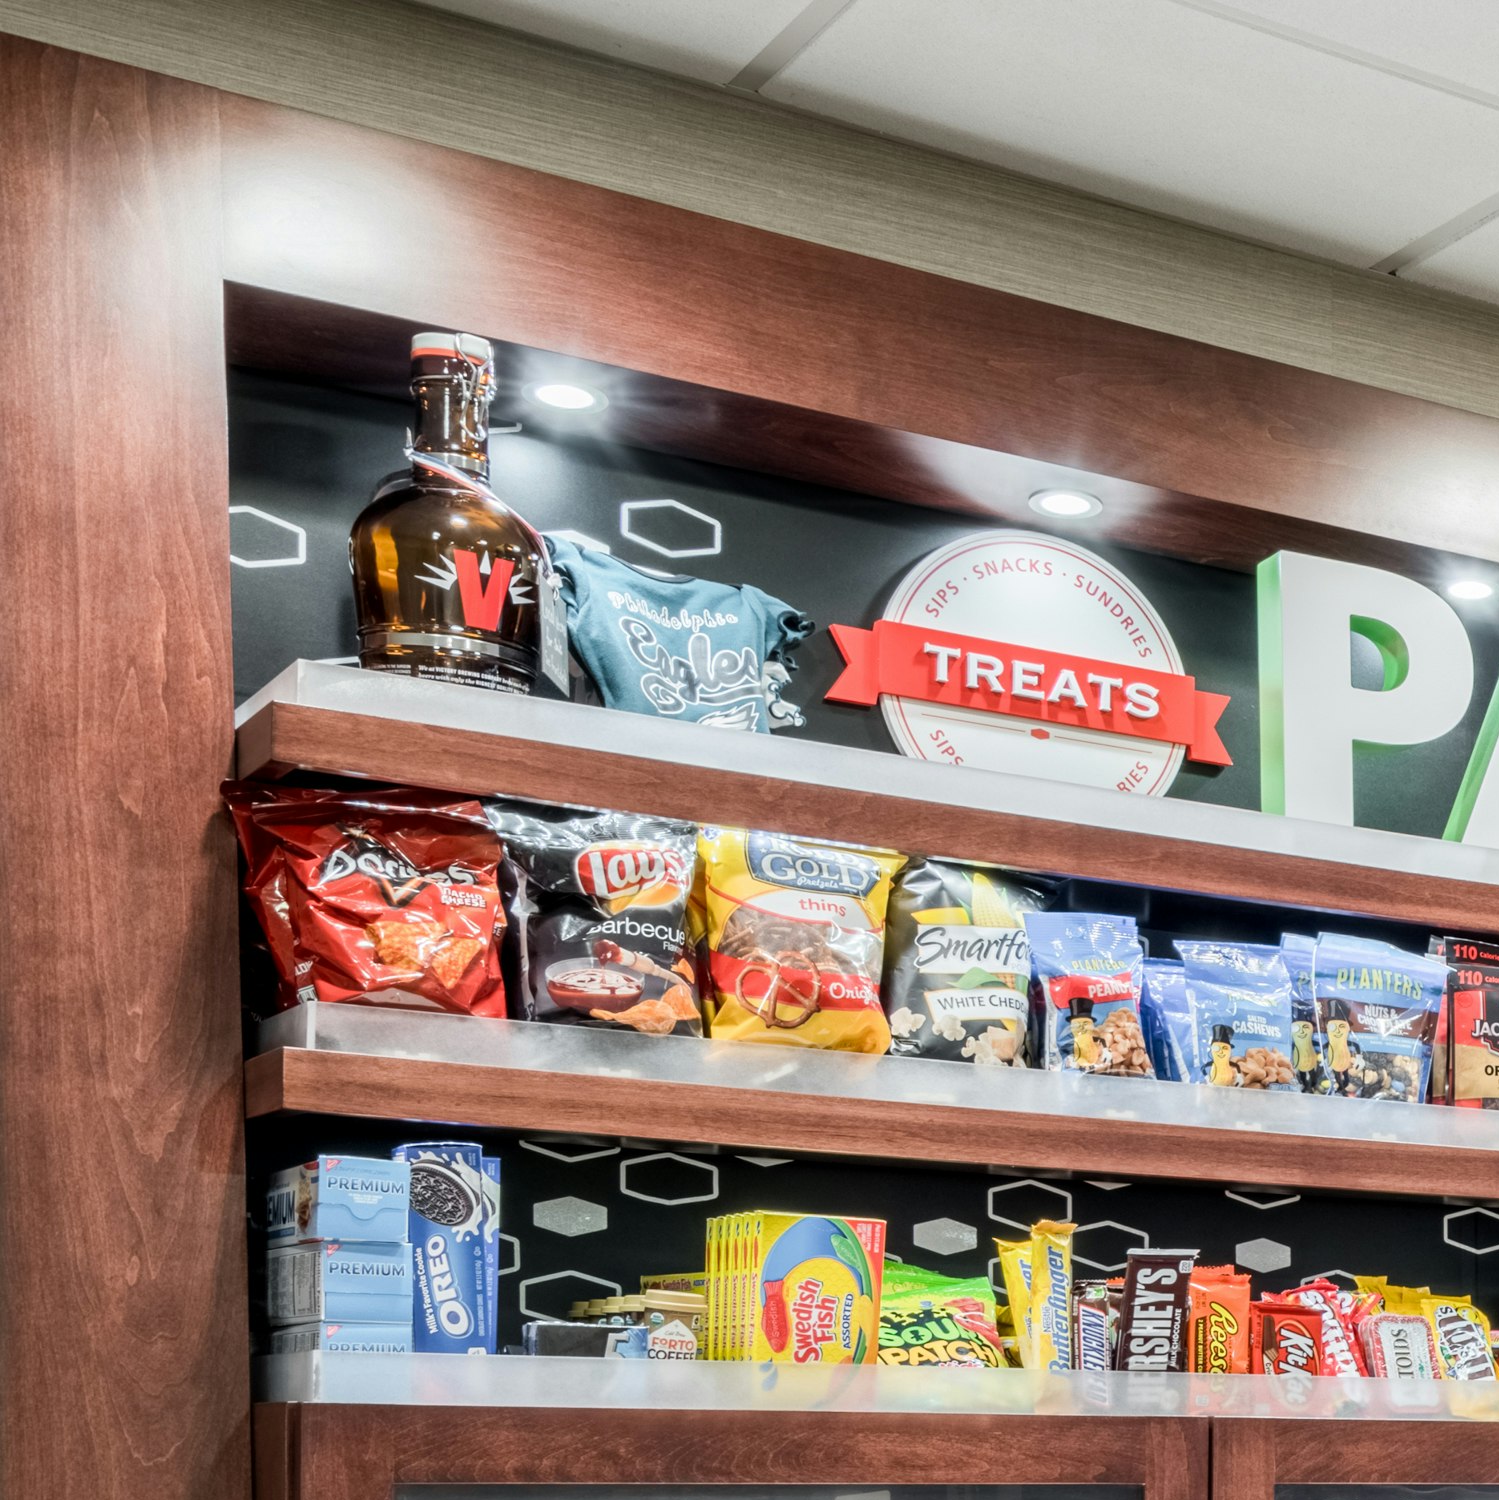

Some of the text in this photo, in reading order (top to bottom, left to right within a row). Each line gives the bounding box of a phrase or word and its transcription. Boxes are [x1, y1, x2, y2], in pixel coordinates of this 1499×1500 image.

[453, 548, 515, 633] V
[925, 558, 1153, 658] SIPS SNACKS SUNDRIES
[607, 591, 739, 633] Philadelphia
[619, 615, 763, 710] Eagles
[922, 642, 1160, 719] TREATS
[761, 853, 870, 891] GOLD
[441, 896, 487, 909] CHEESE
[798, 898, 847, 918] thins
[1453, 944, 1478, 961] 110
[1336, 967, 1423, 1000] PLANTERS
[1457, 969, 1483, 986] 110
[937, 996, 986, 1011] WHITE
[1364, 1004, 1389, 1018] NUTS
[1232, 1020, 1282, 1038] CASHEWS
[327, 1176, 405, 1195] PREMIUM
[329, 1262, 405, 1277] PREMIUM
[414, 1247, 425, 1275] Cookie
[419, 1274, 434, 1309] Favorite
[427, 1235, 471, 1337] OREO
[793, 1278, 824, 1364] Swedish
[815, 1295, 838, 1346] Fish
[841, 1293, 854, 1350] ASSORTED
[1048, 1246, 1071, 1374] Butterfinger
[651, 1337, 695, 1351] FORTO
[1171, 1307, 1182, 1351] CHOCOLATE
[878, 1340, 999, 1368] PATCH
[1280, 1327, 1314, 1367] Kit
